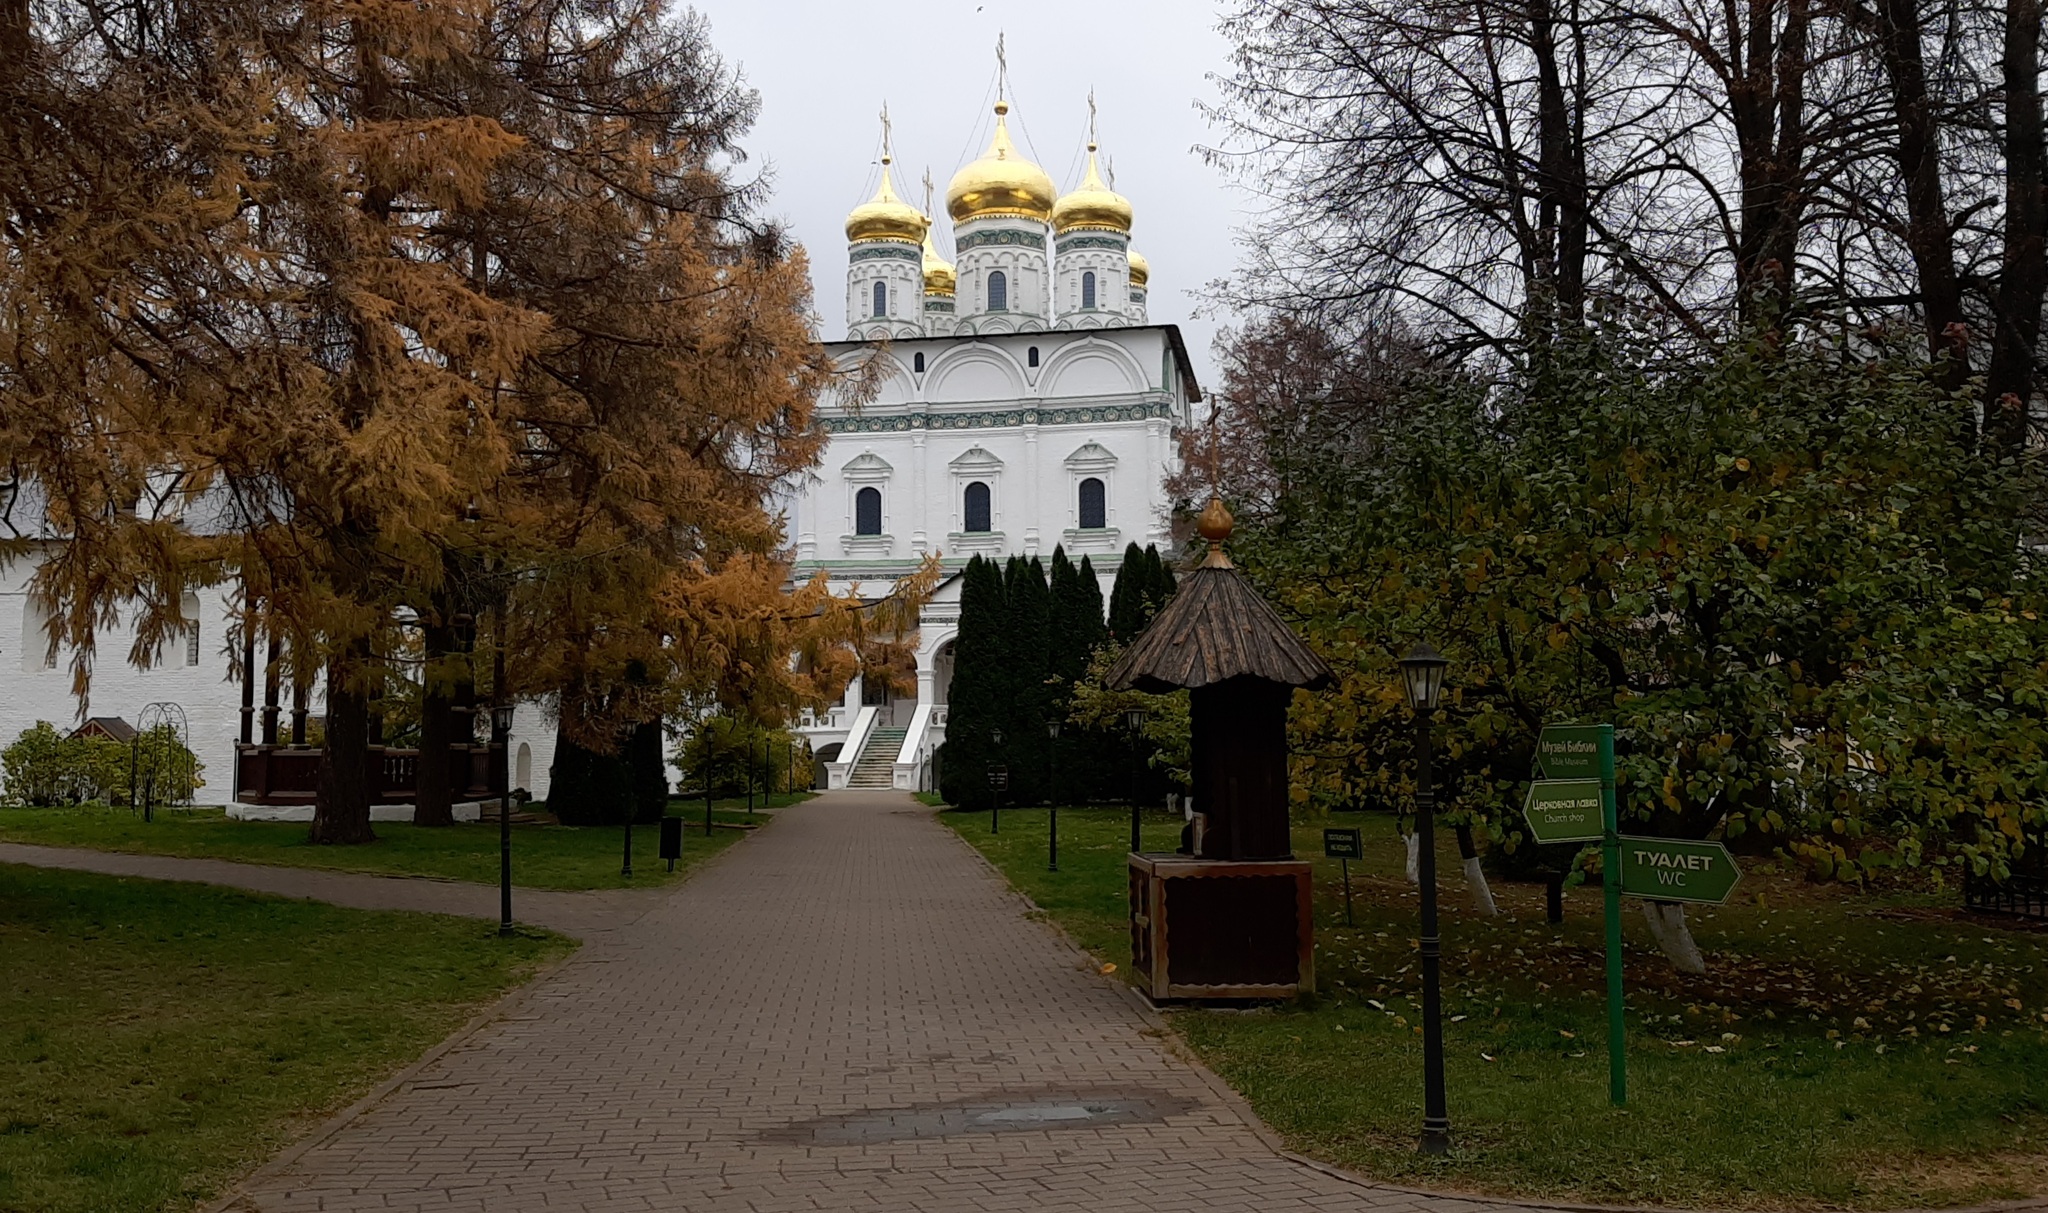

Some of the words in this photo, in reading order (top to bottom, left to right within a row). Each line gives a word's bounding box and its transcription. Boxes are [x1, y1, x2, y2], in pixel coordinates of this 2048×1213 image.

[1542, 741, 1566, 756] Музей
[1567, 740, 1597, 753] Библии
[1532, 799, 1575, 812] Церковная
[1576, 799, 1598, 808] лавка
[1544, 812, 1567, 823] Church
[1568, 812, 1585, 823] shop
[1633, 850, 1713, 871] ТУАЛЕТ
[1657, 869, 1686, 887] WC
